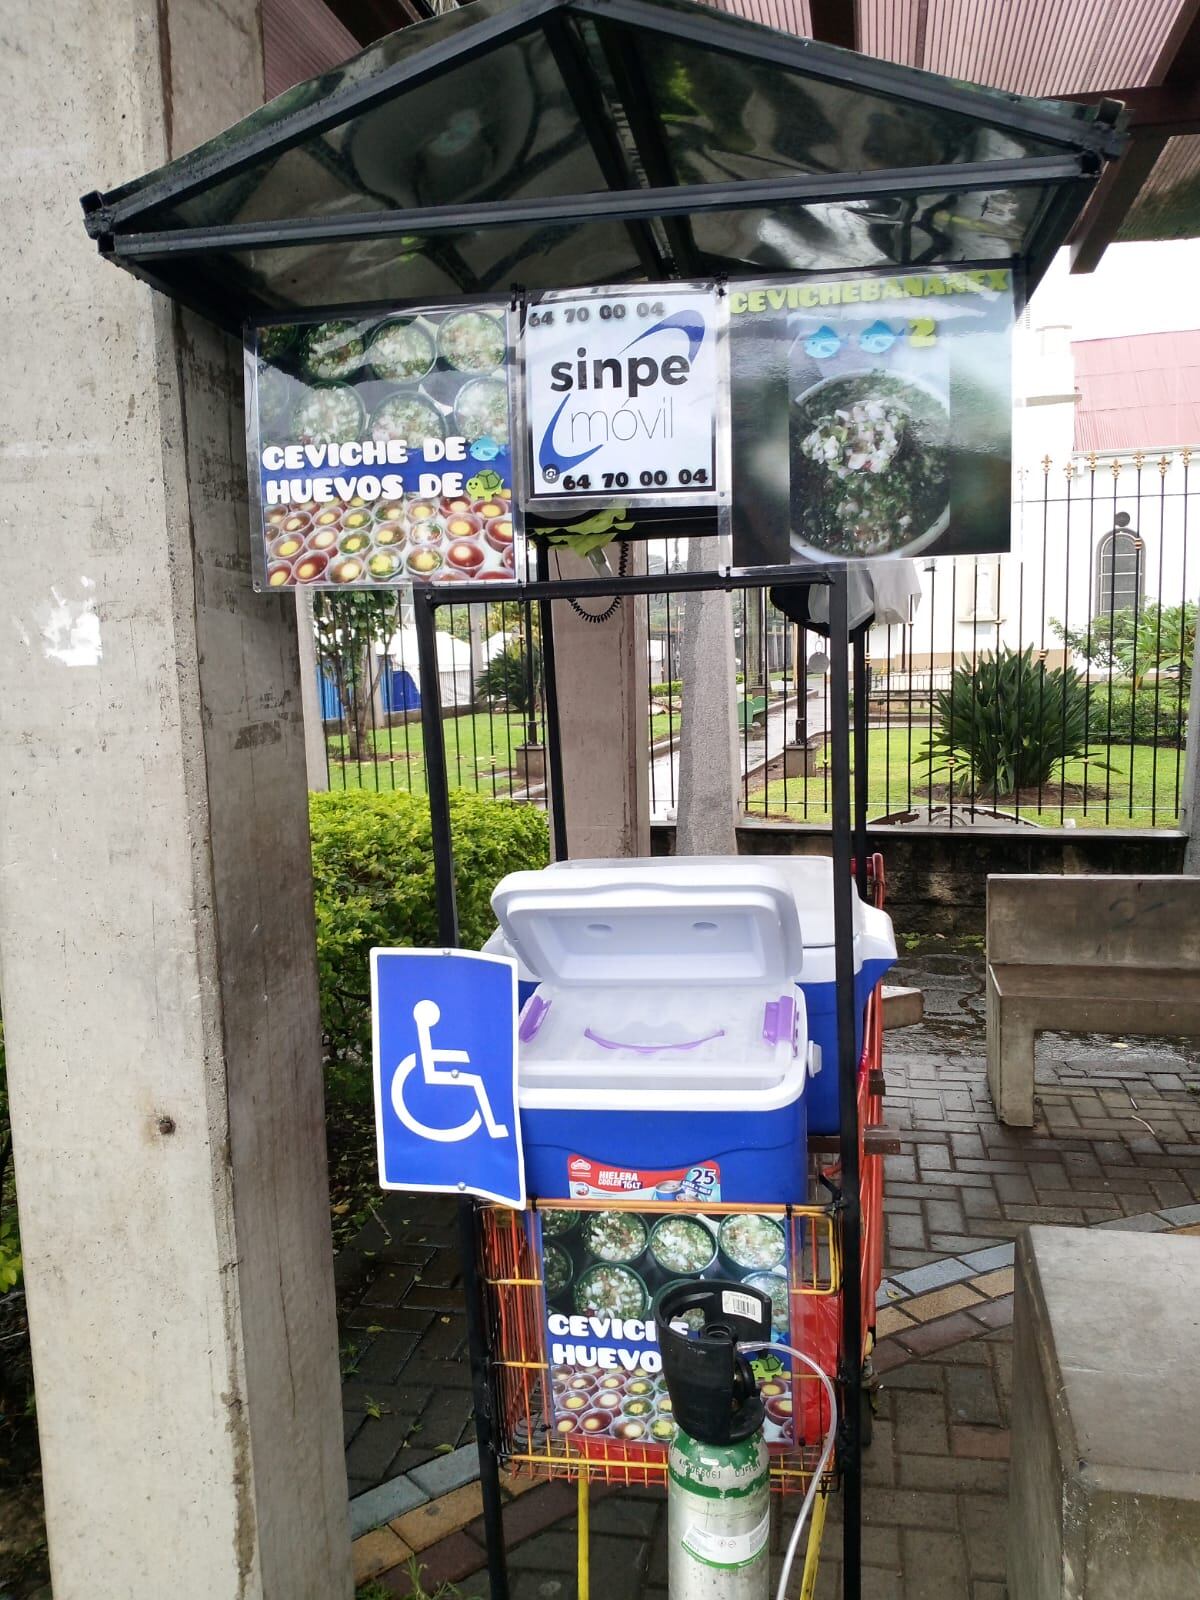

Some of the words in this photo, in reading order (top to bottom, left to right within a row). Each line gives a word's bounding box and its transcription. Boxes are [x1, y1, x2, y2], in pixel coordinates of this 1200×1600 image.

[528, 311, 554, 328] 64
[564, 307, 590, 323] 70
[600, 304, 626, 320] 00
[636, 301, 665, 318] 04
[908, 316, 937, 348] 2
[550, 347, 690, 398] sinpe
[571, 396, 674, 443] móvil
[262, 439, 409, 471] CEVICHE
[423, 436, 467, 463] DE
[266, 474, 403, 505] HUEVOS
[419, 472, 464, 499] DE
[563, 474, 591, 490] 64
[602, 472, 629, 488] 70
[640, 470, 668, 486] 00
[678, 468, 708, 485] 04
[691, 1168, 716, 1186] 25
[552, 1342, 663, 1373] HUEVO
